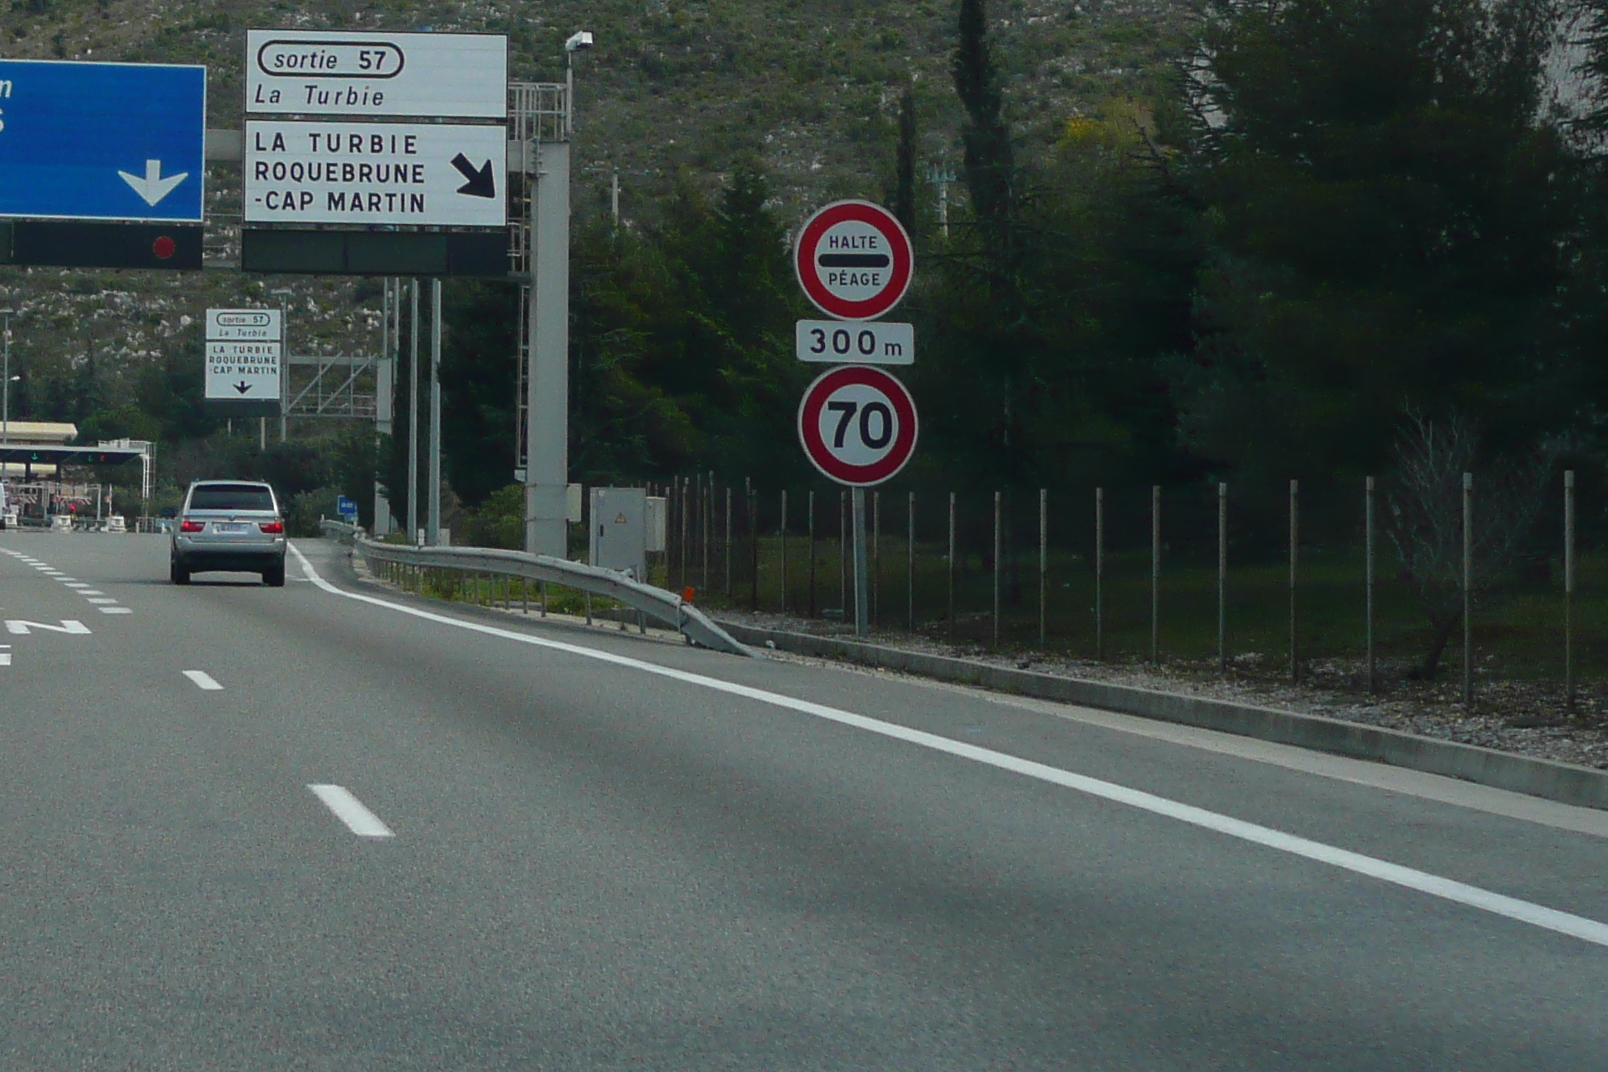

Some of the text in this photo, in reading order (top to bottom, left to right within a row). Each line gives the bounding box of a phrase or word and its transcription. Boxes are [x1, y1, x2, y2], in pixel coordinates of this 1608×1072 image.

[274, 49, 386, 70] sortie 57
[255, 83, 384, 107] La Turbie
[255, 132, 418, 155] LA TURBIE
[255, 161, 425, 185] ROQUEBRUNE
[254, 189, 426, 213] -CAP MARTIN
[829, 236, 878, 249] HALTE
[829, 270, 880, 286] PÉAGE
[213, 346, 225, 354] LA
[810, 328, 902, 356] 300 m
[209, 356, 276, 364] ROQUEBRUNE
[828, 401, 892, 449] 70
